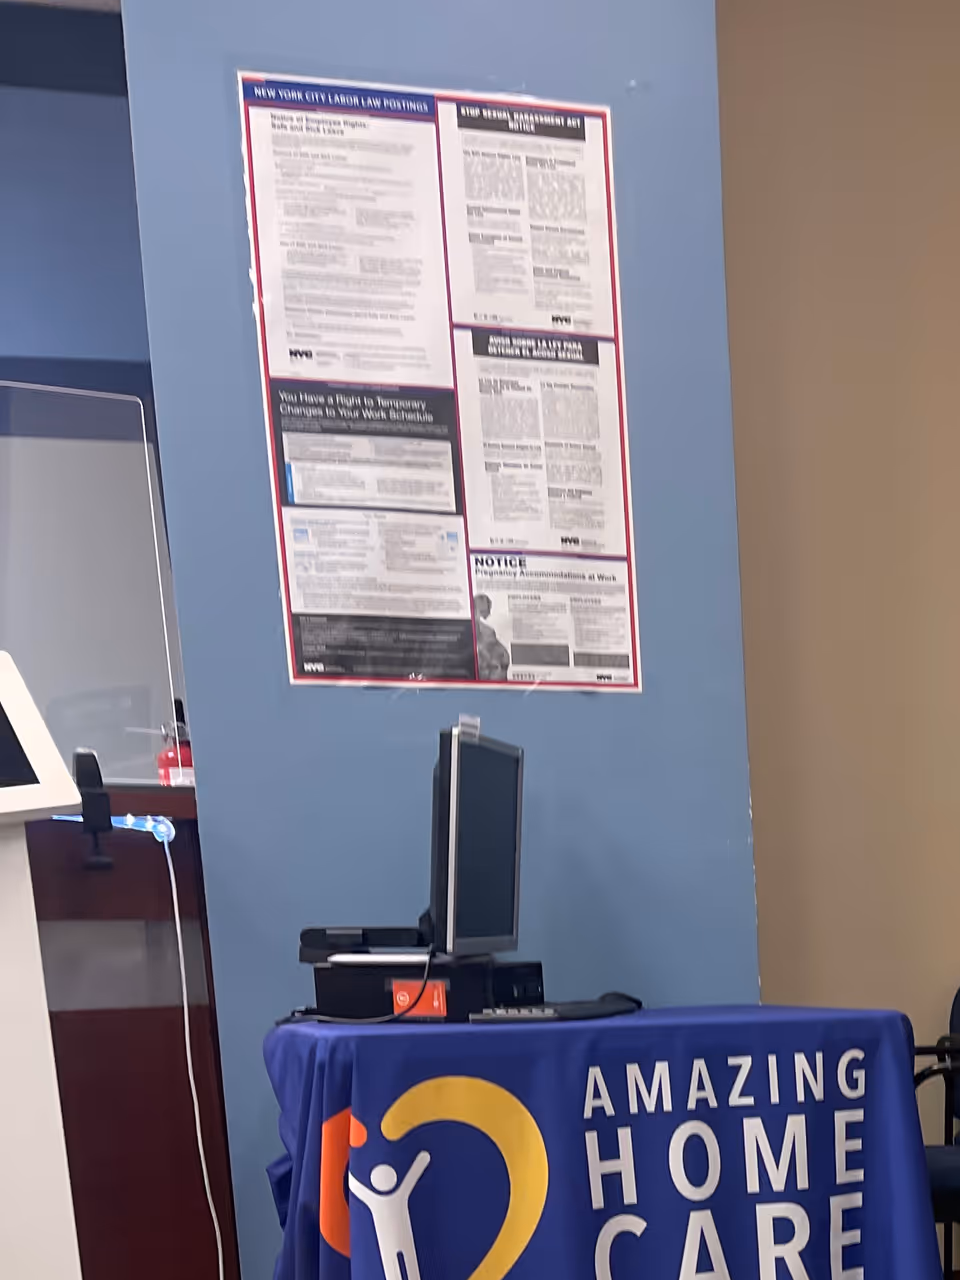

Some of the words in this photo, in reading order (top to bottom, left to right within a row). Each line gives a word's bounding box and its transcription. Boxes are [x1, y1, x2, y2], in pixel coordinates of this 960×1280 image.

[254, 86, 276, 99] NEW
[278, 89, 303, 102] YORK
[306, 91, 326, 104] CITY
[328, 93, 359, 107] LABOR
[361, 96, 381, 108] LAW
[384, 98, 428, 113] POSTINGS
[278, 389, 297, 403] You
[300, 391, 325, 405] Have
[327, 396, 333, 405] a
[335, 393, 361, 409] Right
[363, 395, 374, 407] to
[376, 396, 427, 411] Temporary
[279, 402, 323, 418] Changes
[325, 406, 336, 418] to
[338, 408, 360, 420] Your
[362, 408, 387, 420] Work
[389, 410, 434, 423] Schedule
[474, 556, 527, 569] NOTICE
[475, 567, 517, 579] Pregnancy
[519, 569, 587, 581] Accommodations
[588, 573, 595, 581] at
[596, 573, 618, 582] Work
[583, 1047, 866, 1119] AMAZING
[585, 1108, 865, 1210] HOME
